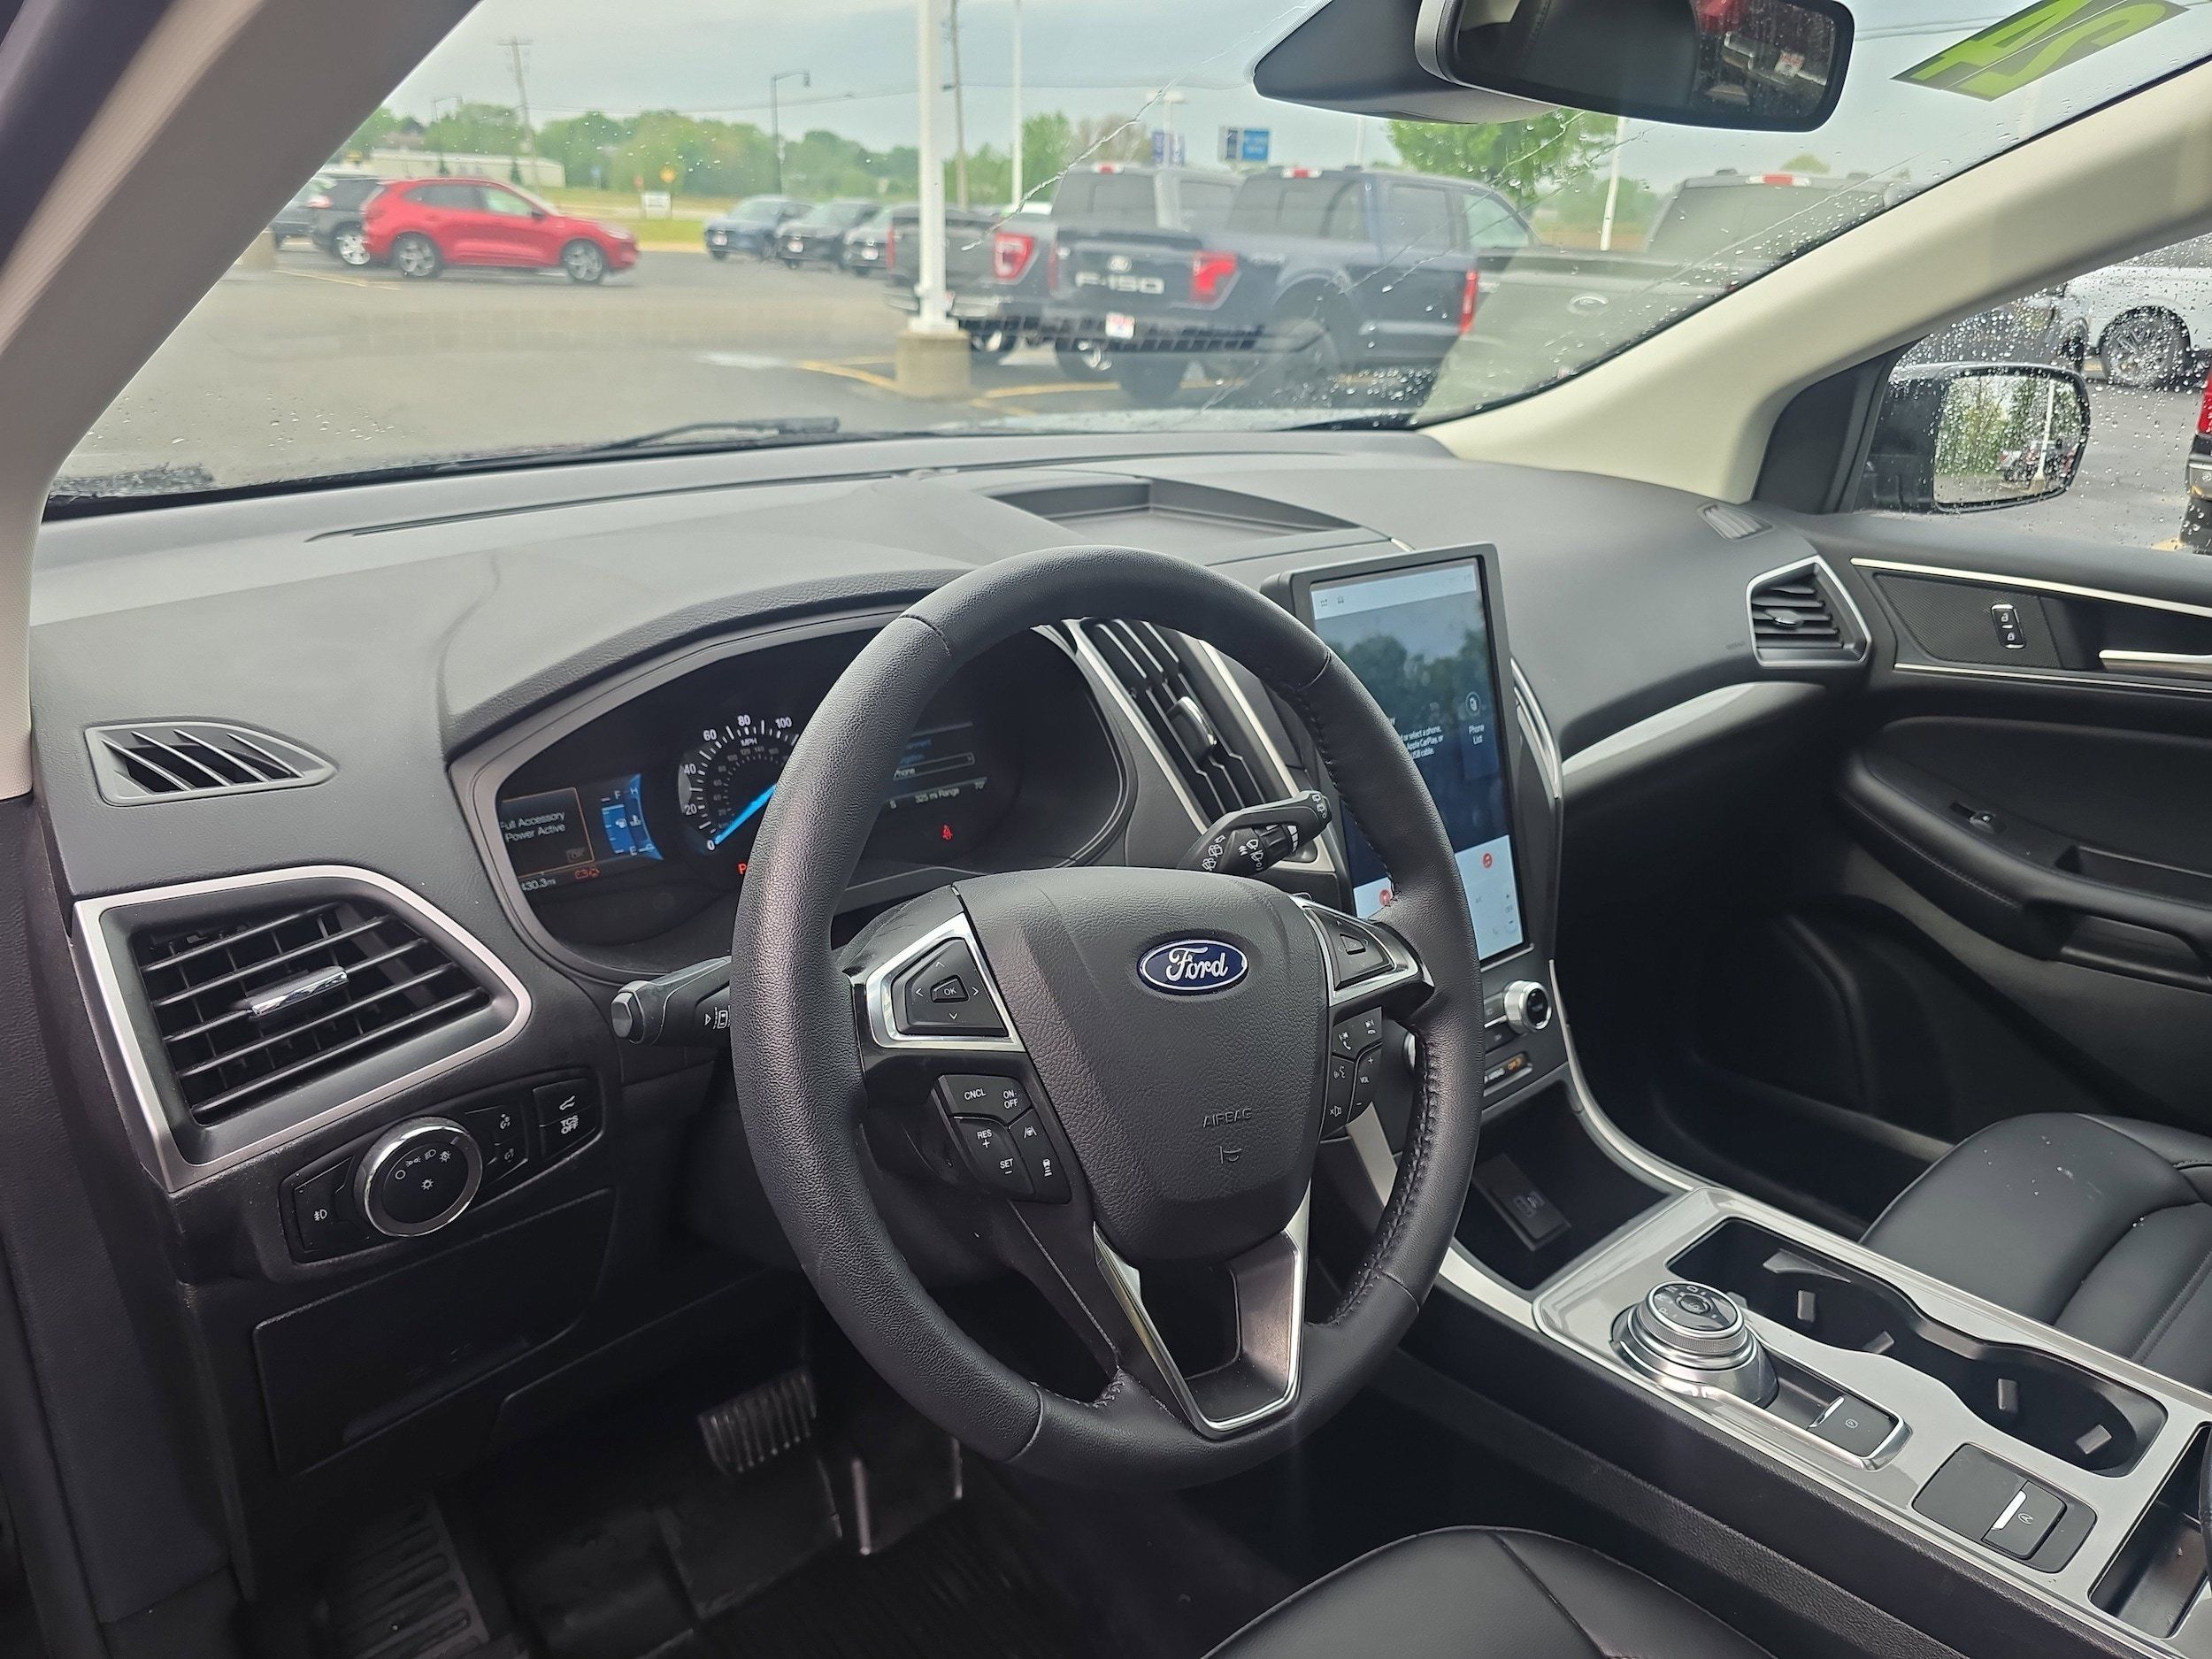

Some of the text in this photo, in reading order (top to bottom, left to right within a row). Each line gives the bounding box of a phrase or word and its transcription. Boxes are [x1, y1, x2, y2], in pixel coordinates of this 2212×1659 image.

[1075, 272, 1165, 295] F-150
[737, 715, 751, 726] 80
[775, 717, 792, 728] 100
[703, 729, 718, 741] 60
[1469, 724, 1485, 735] Phone
[741, 737, 758, 746] MPH
[1473, 735, 1483, 745] List
[684, 763, 697, 774] 40
[939, 788, 960, 798] Range
[684, 803, 697, 815] 20
[518, 810, 565, 828] Accessory
[505, 823, 566, 842] Power Active
[629, 846, 637, 856] E
[707, 840, 716, 851] 0
[738, 863, 747, 875] P
[1166, 947, 1229, 981] Ford
[943, 987, 957, 996] OK
[1360, 1076, 1370, 1085] VOL
[964, 1088, 987, 1100] CNCL
[1003, 1098, 1018, 1109] OFF
[560, 1115, 579, 1127] TCS
[561, 1121, 578, 1134] OFF
[977, 1129, 993, 1140] RES
[1000, 1158, 1014, 1169] SET
